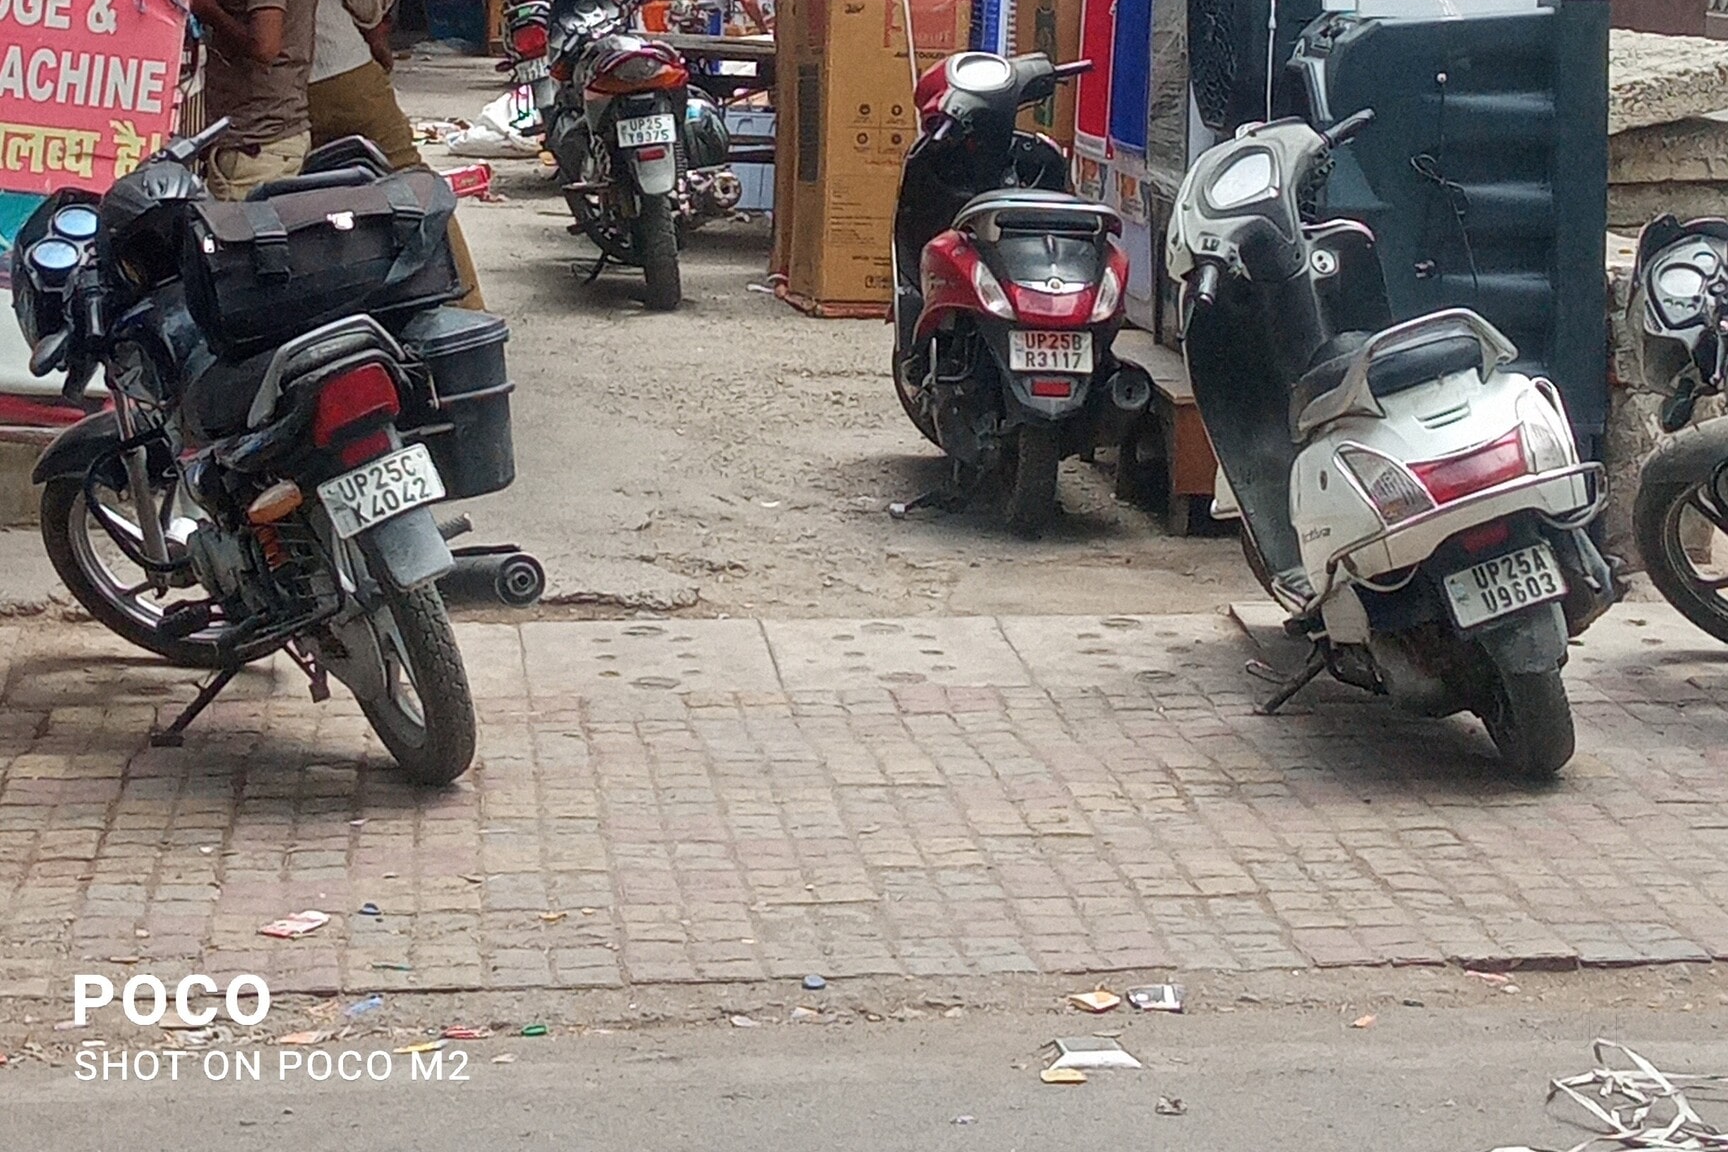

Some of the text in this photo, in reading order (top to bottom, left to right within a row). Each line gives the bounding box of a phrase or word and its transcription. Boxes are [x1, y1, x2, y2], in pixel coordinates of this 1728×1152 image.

[1024, 351, 1082, 369] R3117
[337, 454, 418, 503] UP25C
[1471, 547, 1548, 589] UP25A
[1480, 572, 1557, 614] U9603
